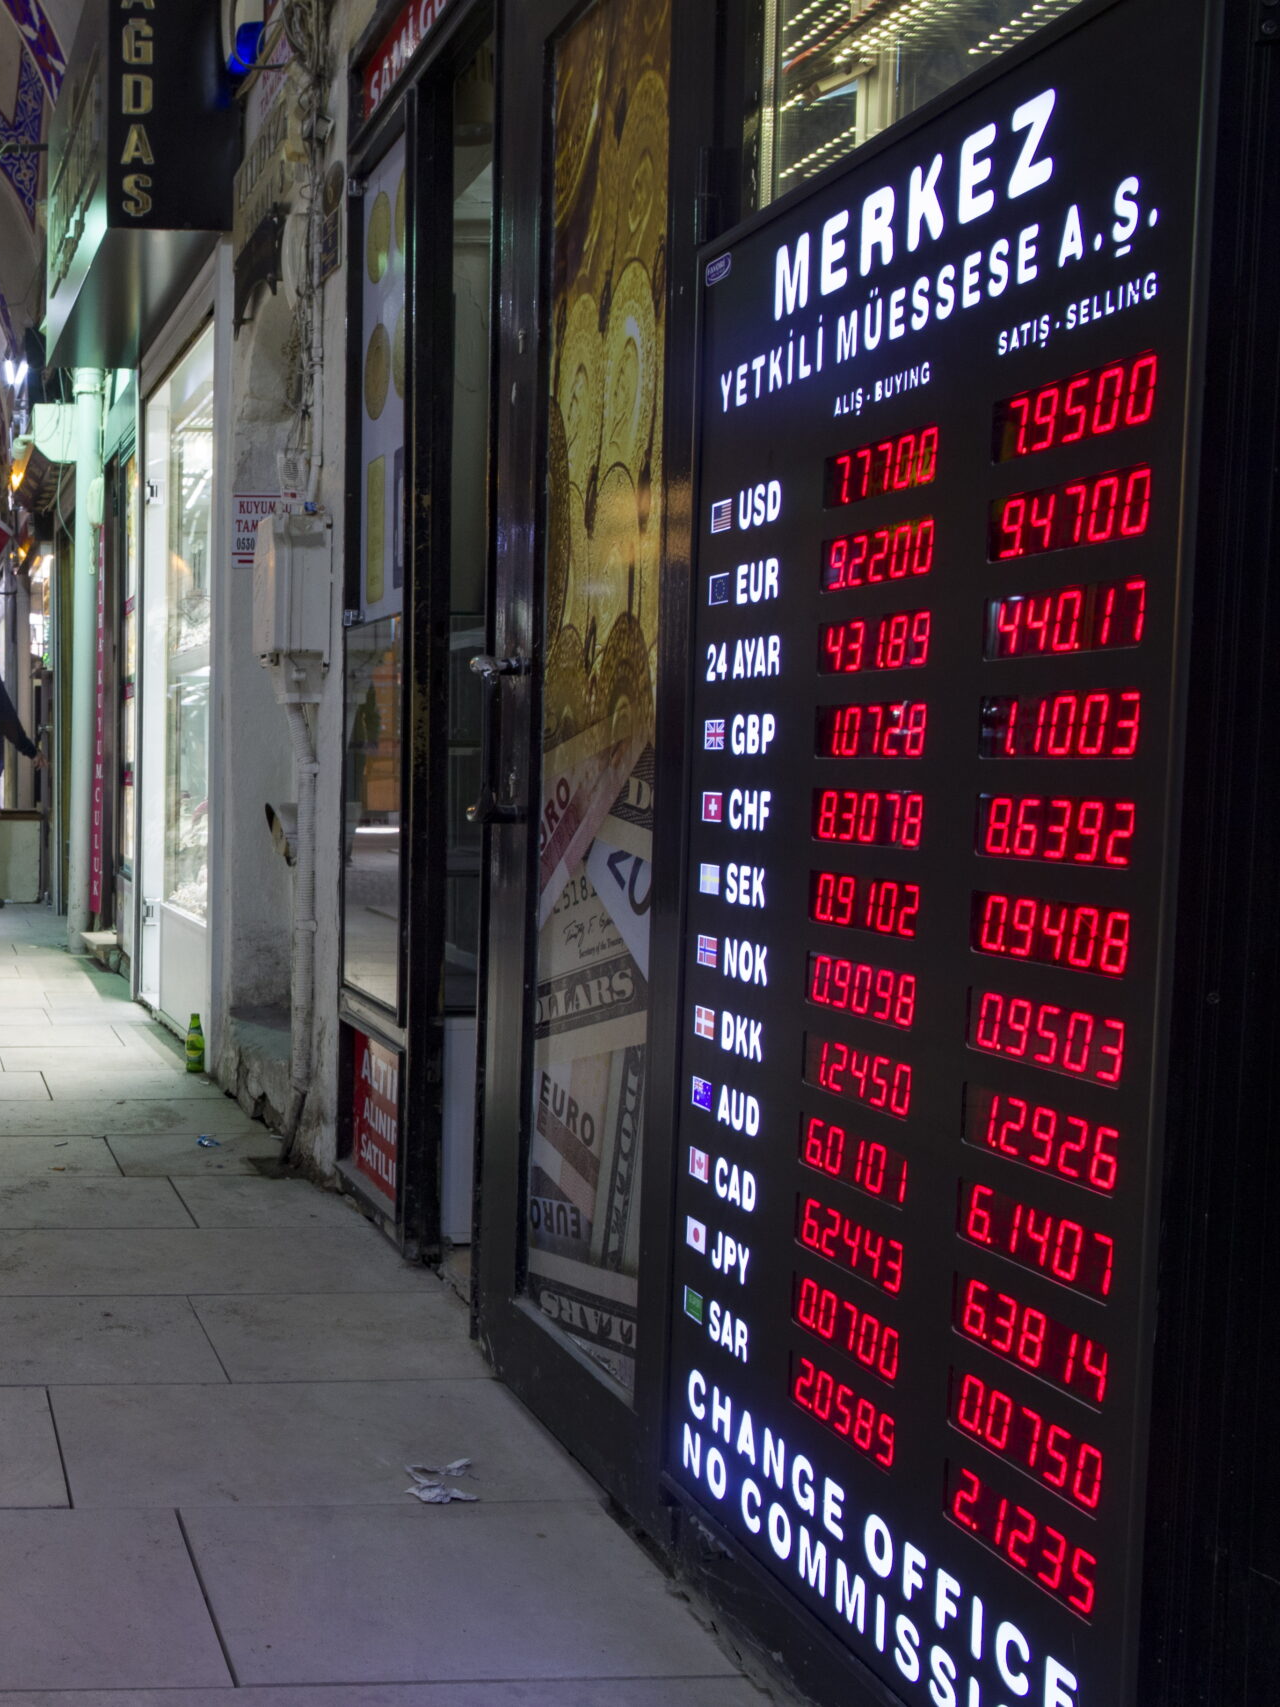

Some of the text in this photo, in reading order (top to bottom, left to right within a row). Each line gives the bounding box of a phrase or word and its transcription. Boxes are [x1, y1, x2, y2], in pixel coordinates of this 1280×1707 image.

[121, 0, 155, 217] ĞDAŞ
[775, 89, 1055, 320] MERKEZ
[721, 315, 823, 412] YETKİLİ
[837, 224, 1038, 363] MÜESSESE
[239, 500, 292, 514] KUYUMU
[739, 480, 781, 530] USD
[736, 558, 778, 604] EUR
[707, 642, 727, 681] 24
[733, 635, 780, 679] AYAR
[732, 714, 775, 755] GBP
[729, 789, 771, 831] CHF
[726, 863, 765, 908] SEK
[724, 937, 767, 986] NOK
[721, 1011, 762, 1062] DKK
[539, 1071, 595, 1148] EURO
[718, 1085, 759, 1136] AUD
[715, 1157, 756, 1212] CAD
[712, 1232, 749, 1284] JPY
[709, 1301, 747, 1362] SAR
[683, 1425, 726, 1499] NO
[685, 1372, 844, 1541] CHANGE
